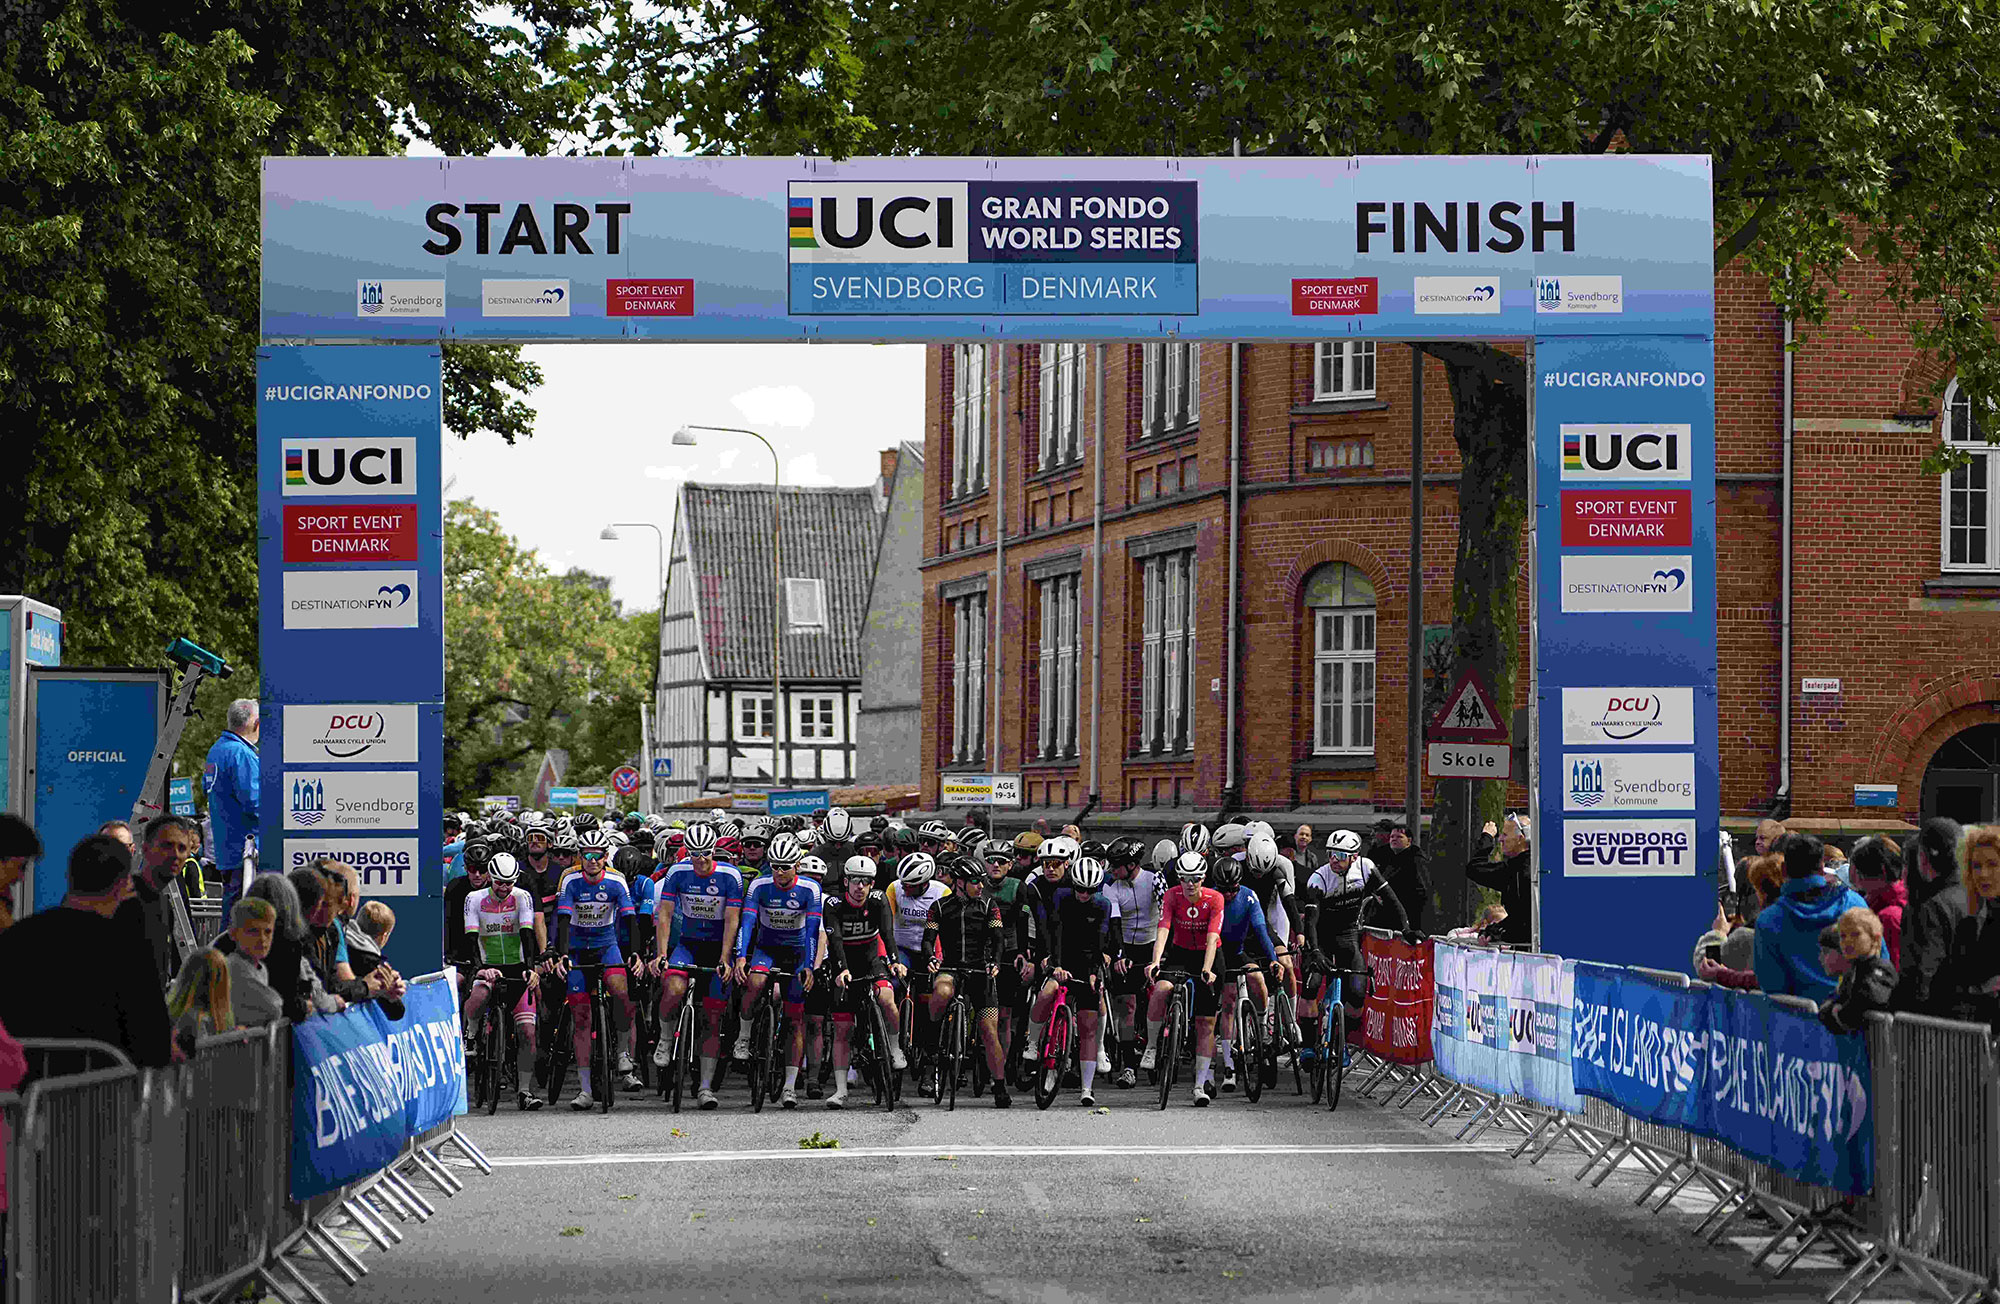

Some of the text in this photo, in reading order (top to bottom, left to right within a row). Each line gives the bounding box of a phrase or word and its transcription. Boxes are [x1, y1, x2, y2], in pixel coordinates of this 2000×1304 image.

[980, 196, 1169, 220] GRAN FONDO
[421, 202, 631, 256] START
[820, 196, 954, 250] UCI
[1356, 201, 1575, 253] FINISH
[981, 227, 1182, 250] WORLD SERIES
[616, 284, 684, 297] SPORT EVENT
[812, 276, 1157, 299] SVENDBORG DENMARK
[1301, 283, 1368, 297] SPORT EVENT
[390, 295, 443, 308] Svendborg
[1310, 299, 1361, 310] DENMARK
[1567, 291, 1619, 304] Svendborg
[624, 300, 676, 312] DENMARK
[1544, 372, 1705, 387] #UCIGRANFONDO
[265, 385, 431, 401] #UCIGRANFONDO
[1585, 433, 1677, 471] UCI
[307, 447, 402, 485] UCI
[1575, 501, 1677, 514] SPORT EVENT
[298, 515, 402, 529] SPORT EVENT
[1589, 524, 1665, 537] DENMARK
[312, 539, 390, 552] DENMARK
[1569, 583, 1667, 593] DESTINATIONFYN
[291, 600, 392, 610] DESTINATIONFYN
[1608, 698, 1650, 711] DCU
[330, 715, 373, 729] DCU
[67, 751, 127, 763] OFFICIAL
[1442, 752, 1495, 767] Skole
[1614, 780, 1691, 796] Svendborg
[335, 798, 415, 815] Svendborg
[1614, 797, 1658, 805] Kommune
[335, 815, 381, 824] Kommune
[1572, 832, 1687, 845] SVENDBORG
[1572, 846, 1688, 865] EVENT
